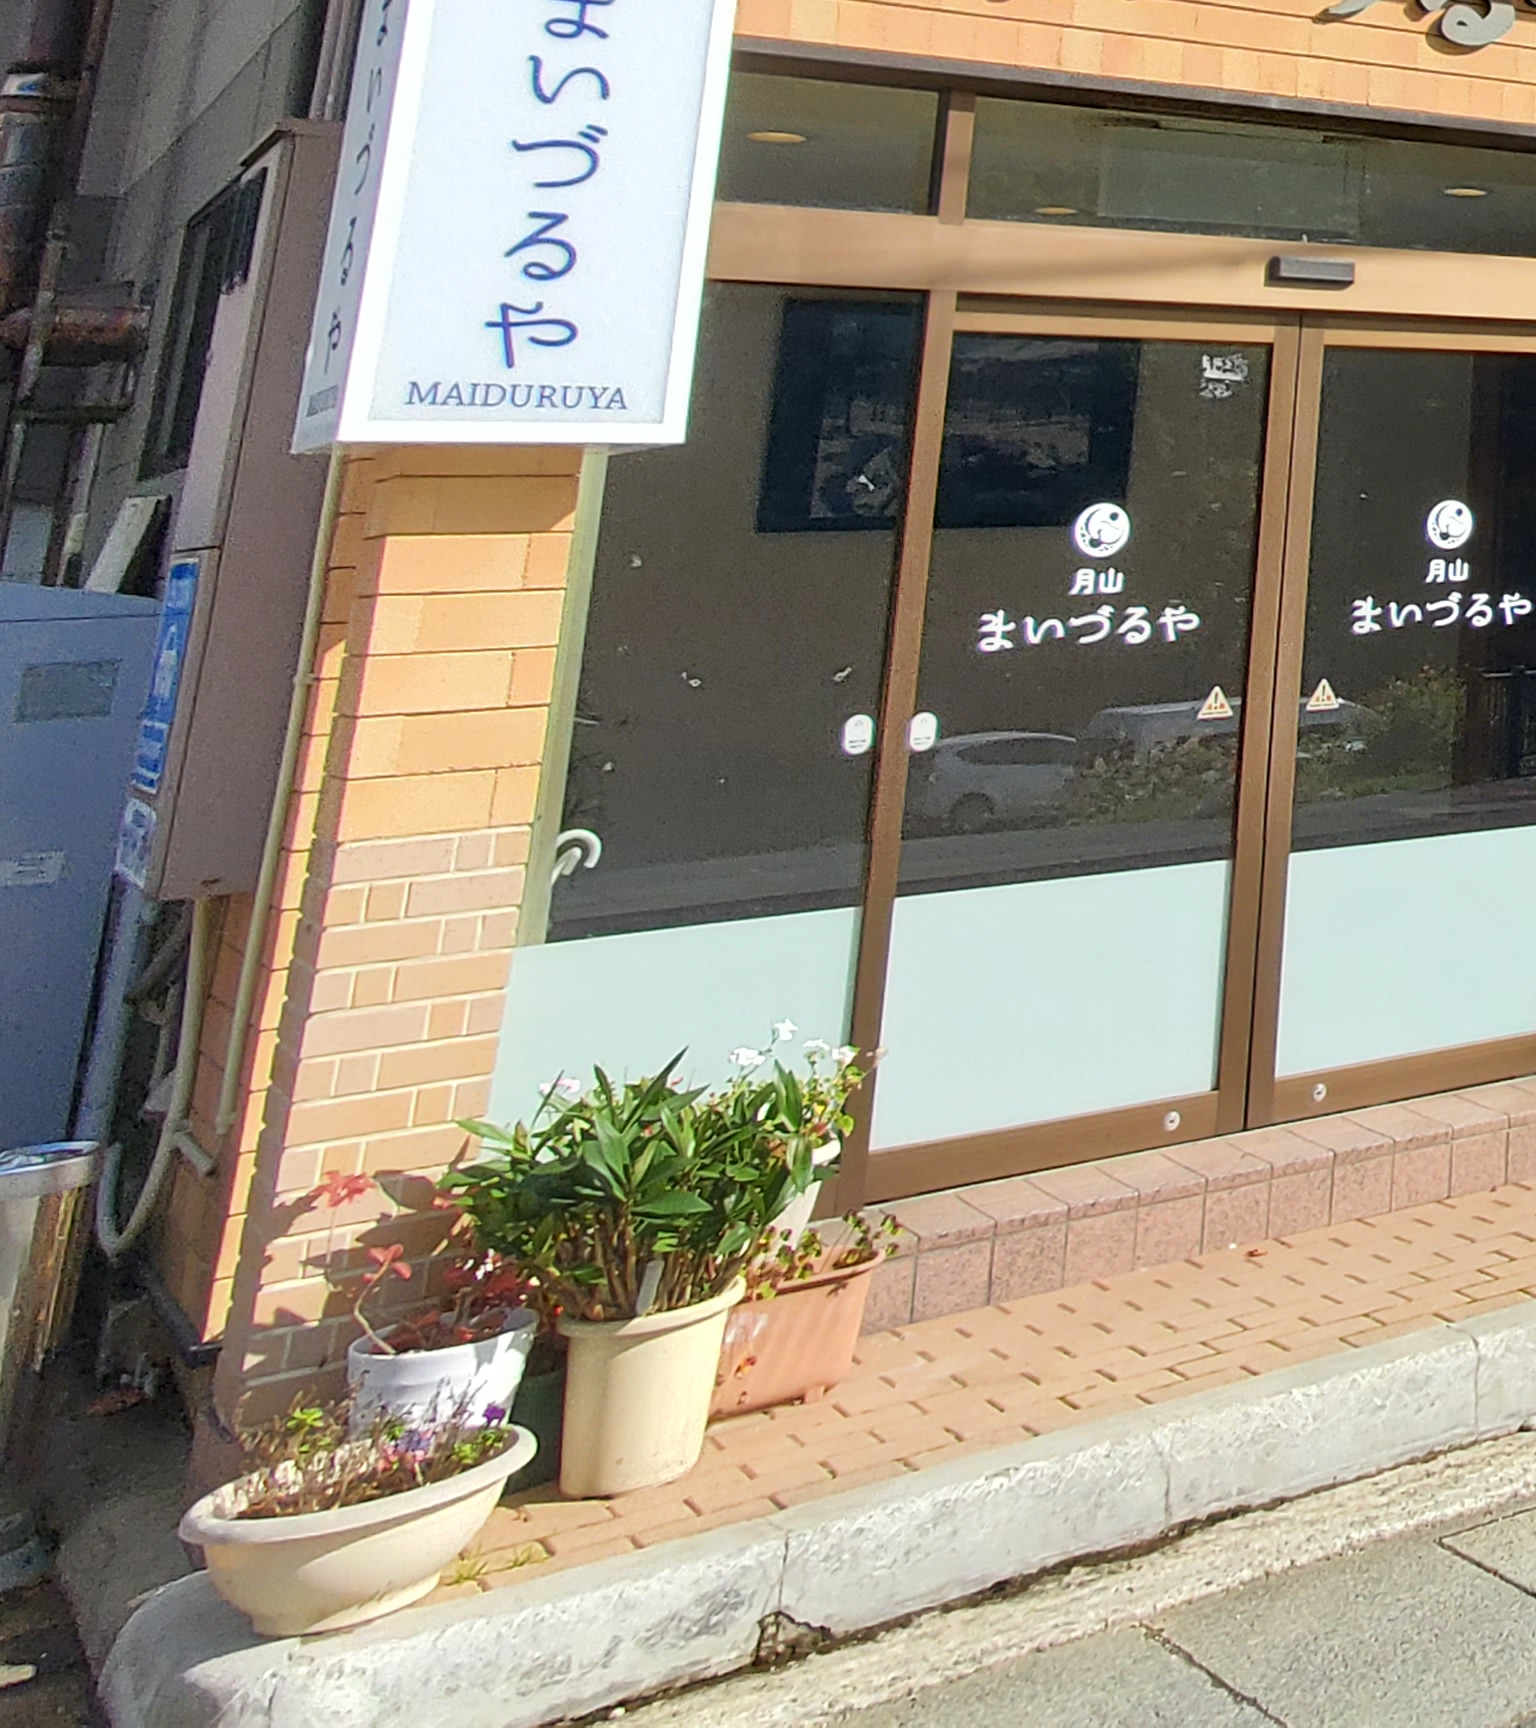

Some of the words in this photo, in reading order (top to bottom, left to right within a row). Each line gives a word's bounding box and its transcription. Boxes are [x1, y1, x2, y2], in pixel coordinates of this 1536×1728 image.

[406, 380, 628, 412] MAIDURUYA
[1068, 567, 1126, 596] 月山
[1424, 557, 1470, 584] 月山
[977, 604, 1202, 653] まいづるや
[1351, 591, 1533, 635] まいづるや
